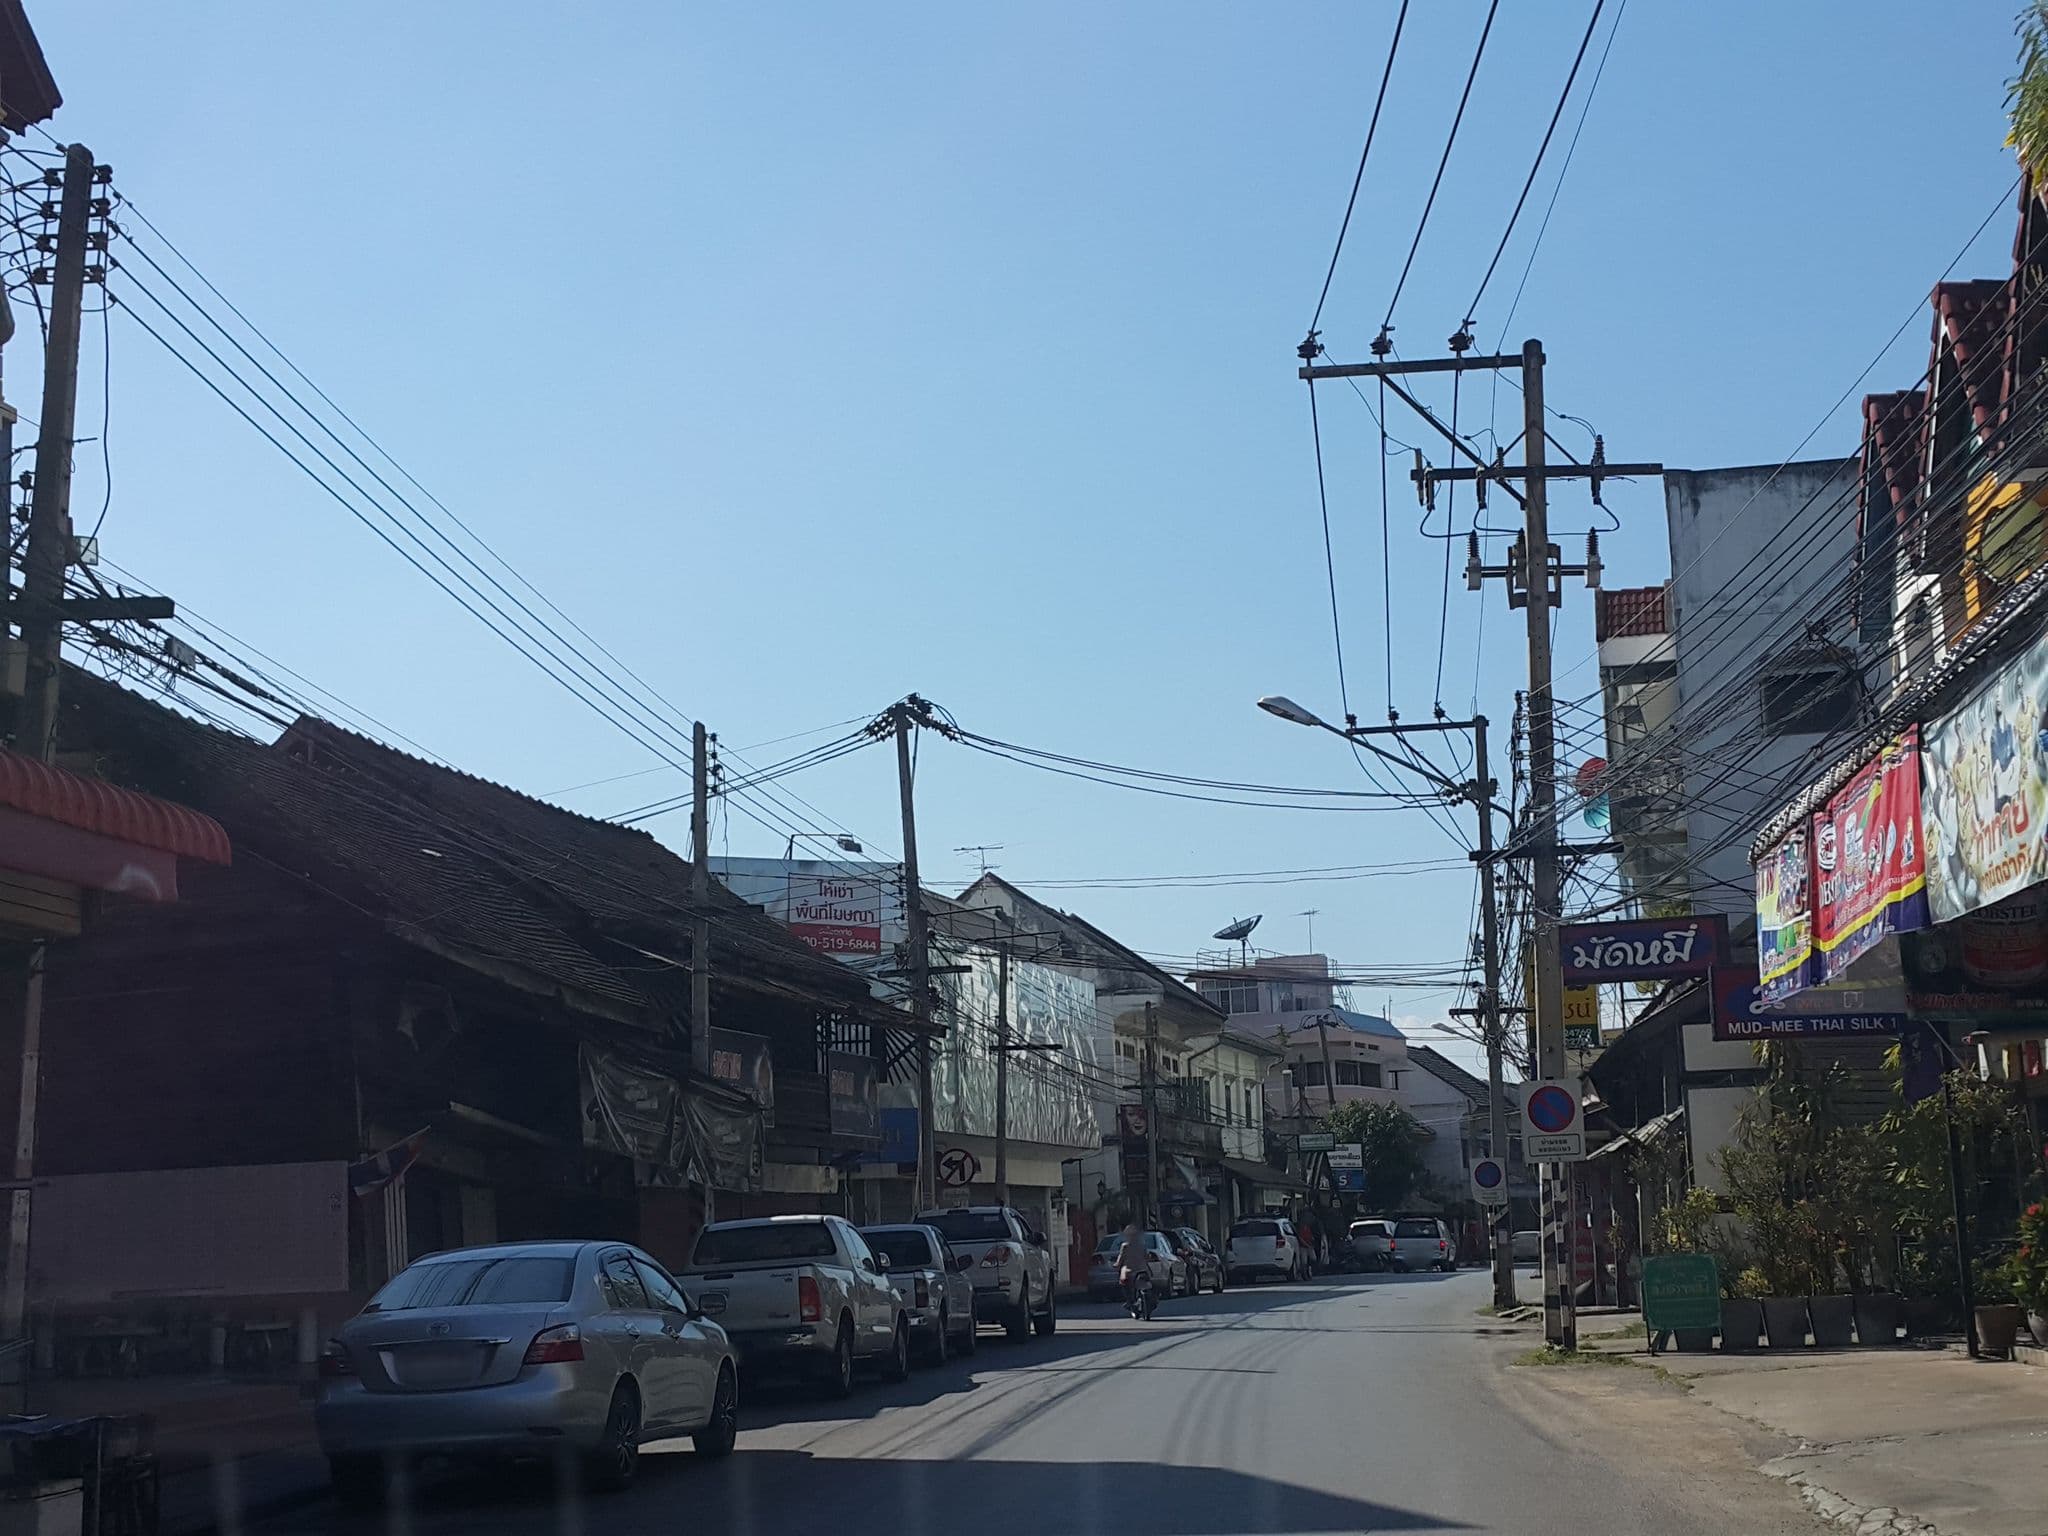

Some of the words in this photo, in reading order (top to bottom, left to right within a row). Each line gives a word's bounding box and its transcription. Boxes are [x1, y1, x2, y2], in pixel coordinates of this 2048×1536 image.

[817, 879, 853, 898] ให้เช่า
[796, 899, 874, 923] พื้นที่โฆษณา
[798, 935, 877, 951] 0-519-6844
[1573, 923, 1698, 969] มัดหมี่
[1728, 1018, 1804, 1035] MUD-MEE
[1810, 1017, 1844, 1031] THAI
[1850, 1016, 1884, 1030] SILK
